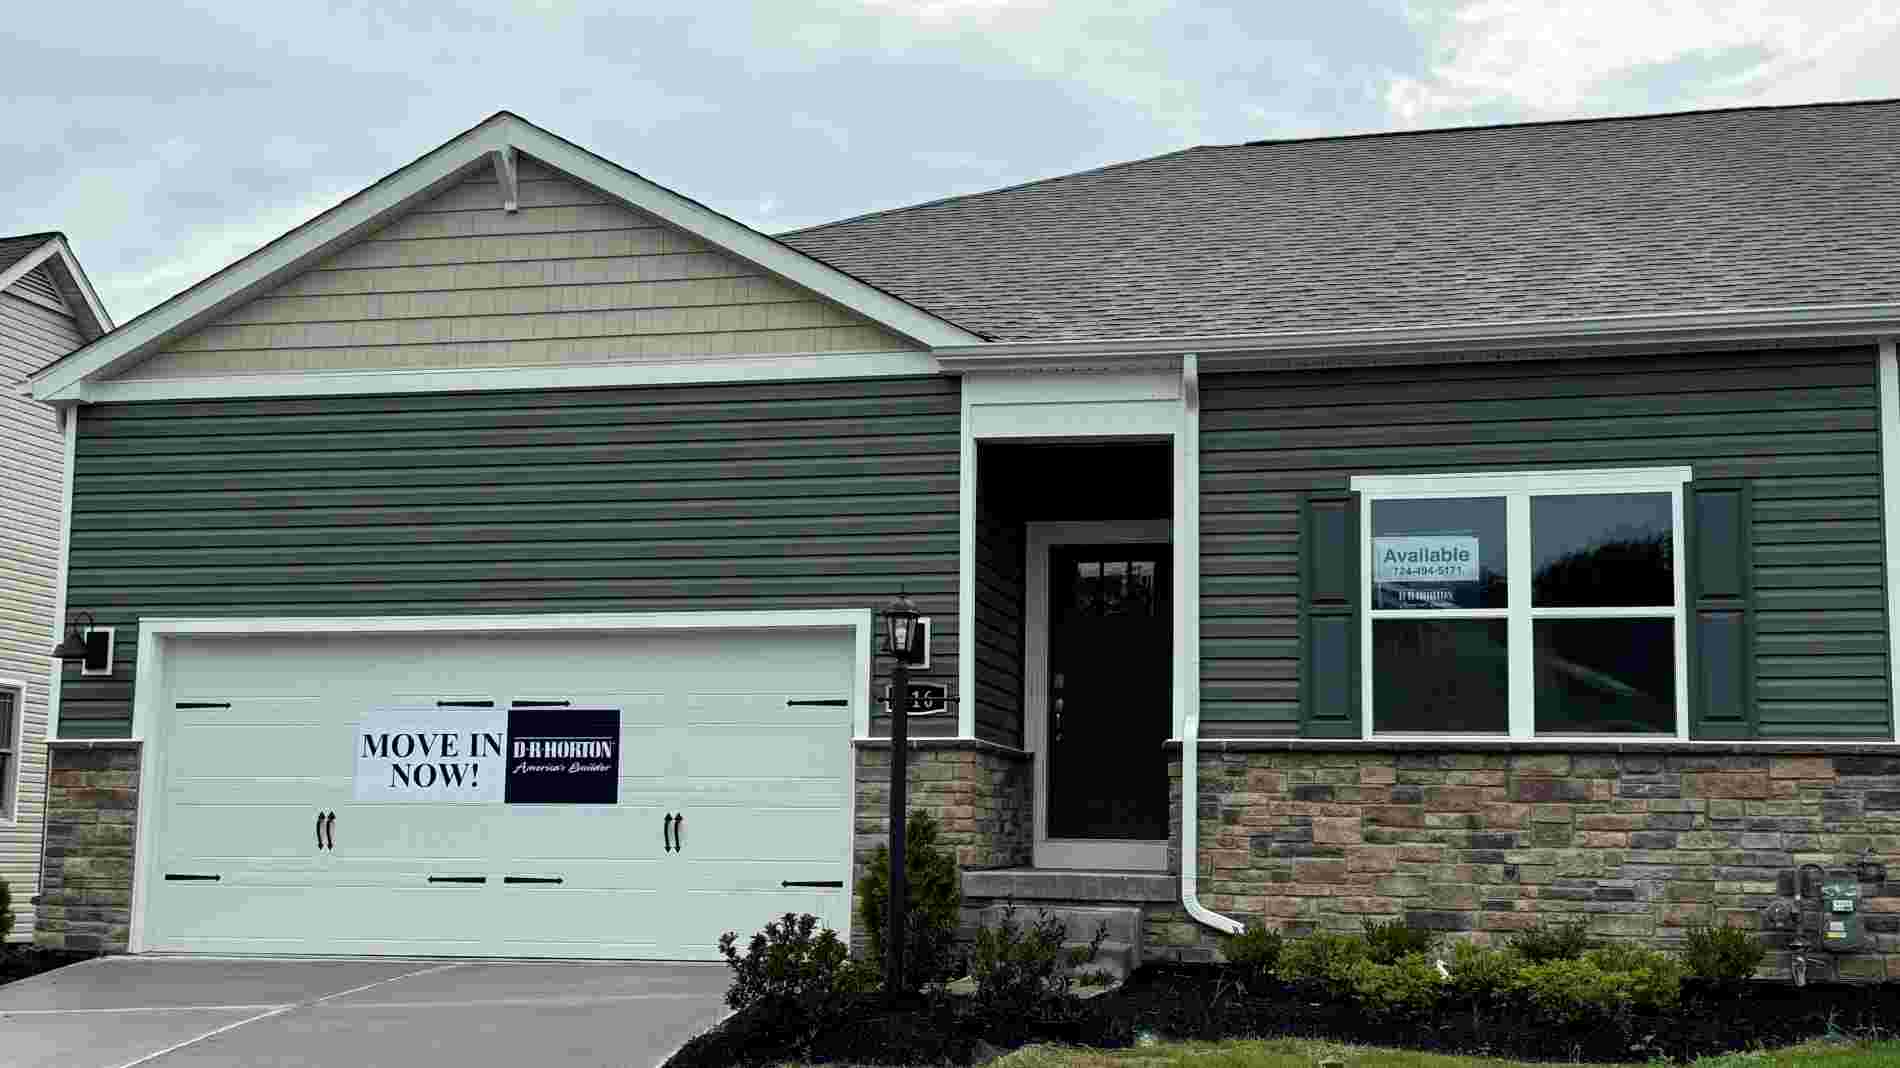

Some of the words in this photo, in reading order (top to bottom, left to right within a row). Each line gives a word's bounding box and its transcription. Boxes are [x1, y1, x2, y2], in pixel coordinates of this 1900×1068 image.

[1383, 547, 1470, 562] Available
[360, 733, 458, 758] MOVE
[469, 733, 504, 758] IN
[387, 763, 480, 788] NOW!
[567, 761, 612, 774] Builder
